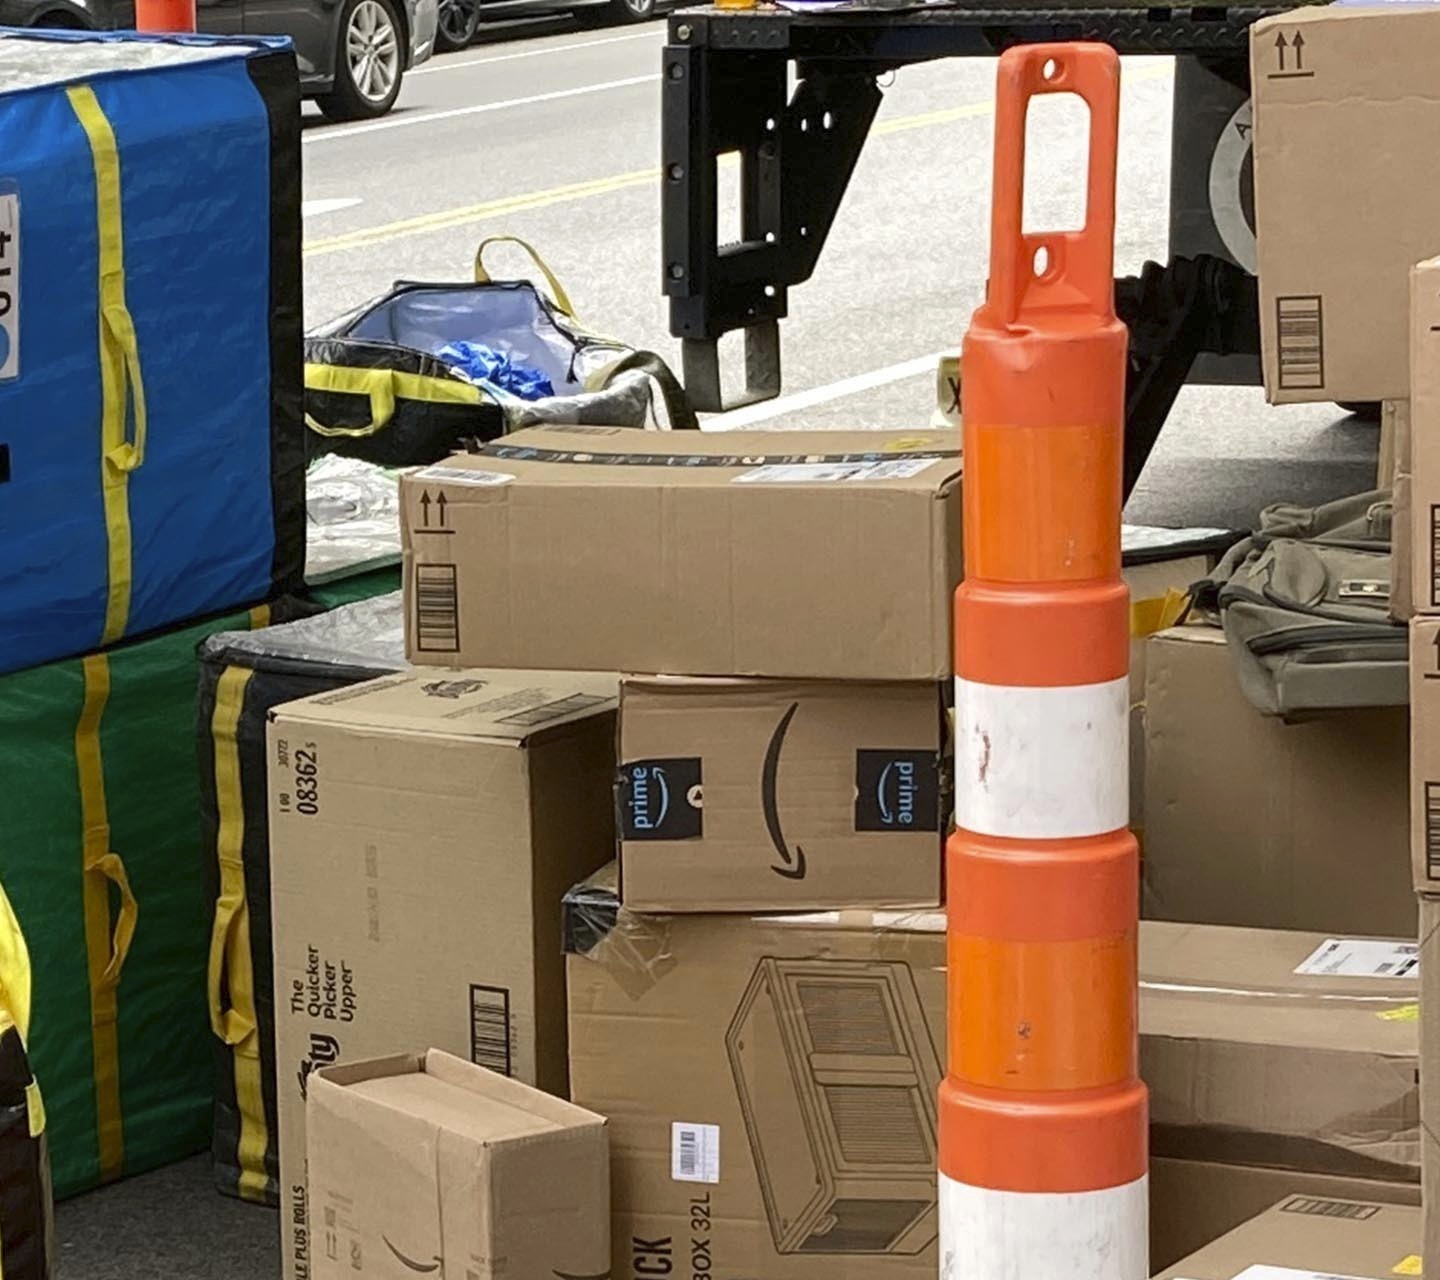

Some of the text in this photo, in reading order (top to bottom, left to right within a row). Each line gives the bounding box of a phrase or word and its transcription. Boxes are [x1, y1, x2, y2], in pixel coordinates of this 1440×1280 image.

[295, 749, 319, 816] 08362
[629, 767, 654, 830] prime
[893, 761, 919, 825] prime
[291, 979, 305, 1015] The
[306, 943, 321, 1018] Quicker
[323, 960, 339, 1021] Picker
[340, 959, 358, 1023] Upper
[292, 1185, 307, 1226] ROLLS
[689, 1191, 712, 1232] 32L
[293, 1229, 307, 1267] PLUS
